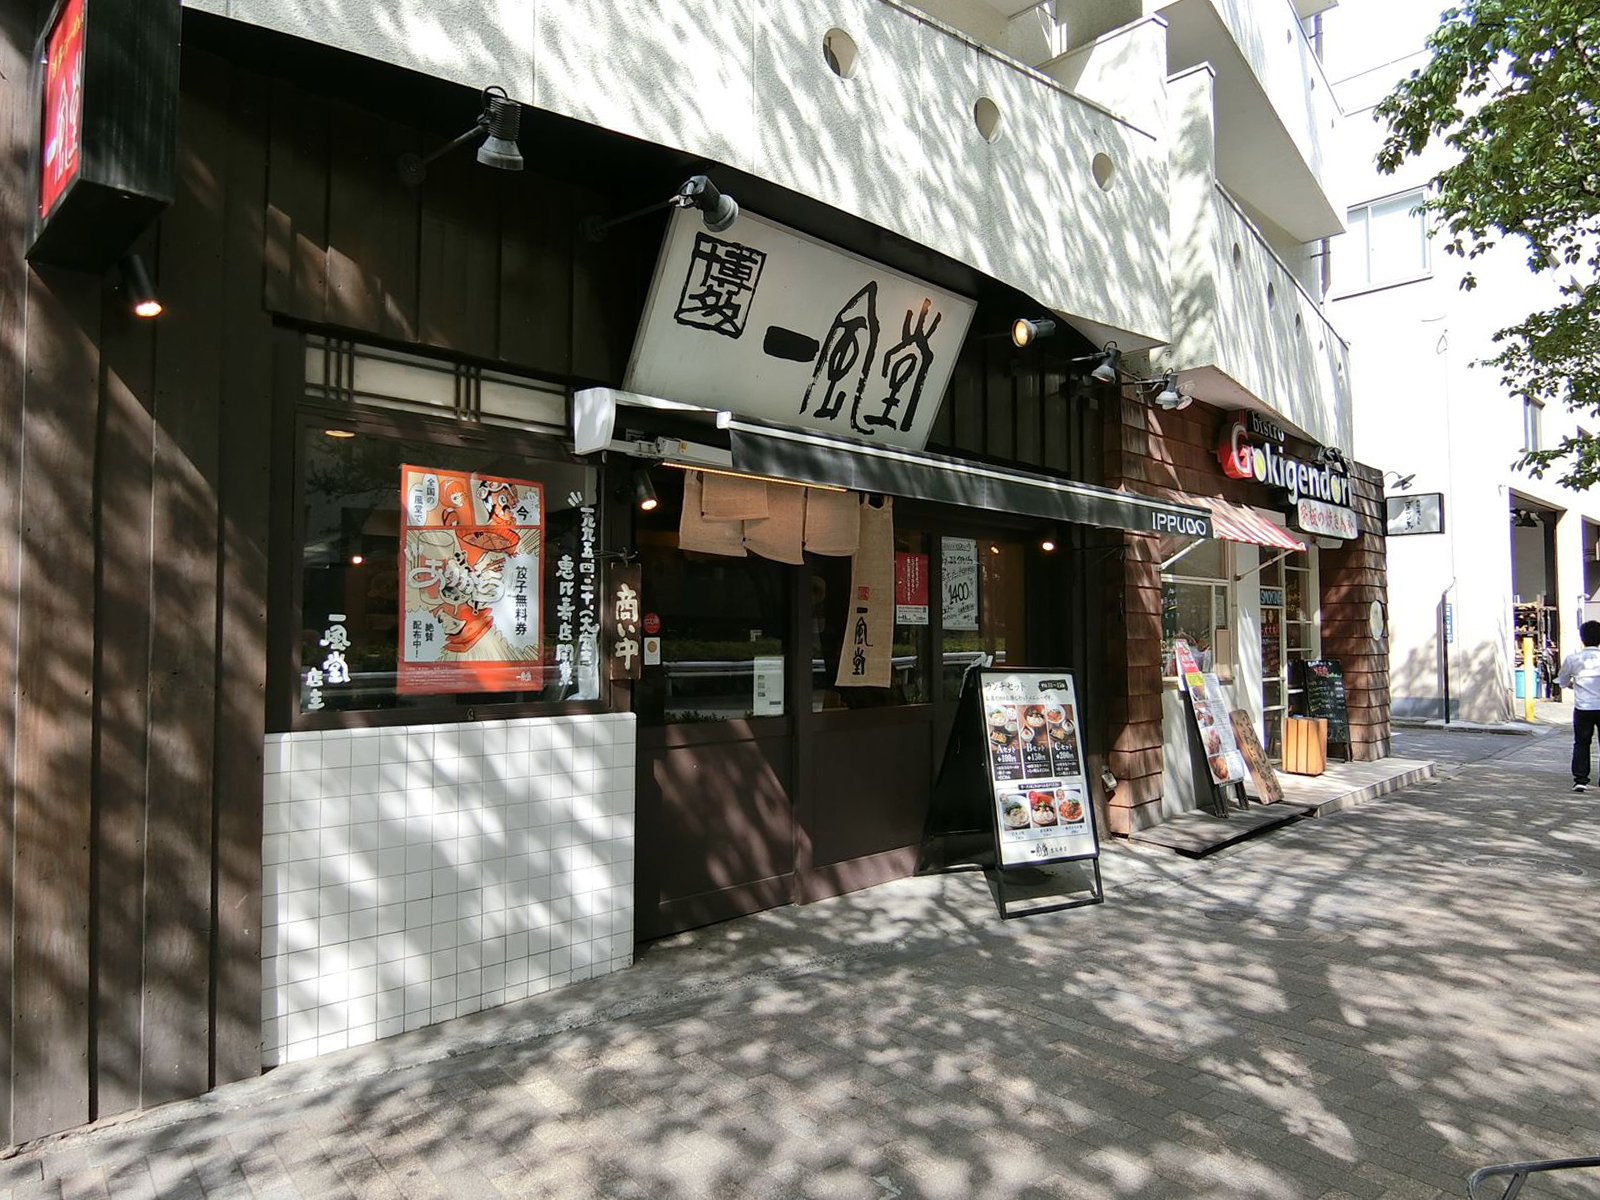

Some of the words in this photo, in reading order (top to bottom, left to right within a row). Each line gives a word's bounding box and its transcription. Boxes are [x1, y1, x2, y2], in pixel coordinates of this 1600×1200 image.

[762, 280, 942, 435] 一風堂
[1252, 409, 1285, 442] bistro
[426, 478, 435, 504] 全国の
[1231, 420, 1354, 508] Gokigendori
[1152, 511, 1207, 536] IPPUDO
[424, 623, 434, 642] 絶賛
[515, 565, 528, 636] 餃子無料券
[614, 583, 639, 671] 商い中
[319, 613, 352, 684] 一風堂
[851, 606, 874, 676] 一風堂
[306, 666, 326, 710] 店主
